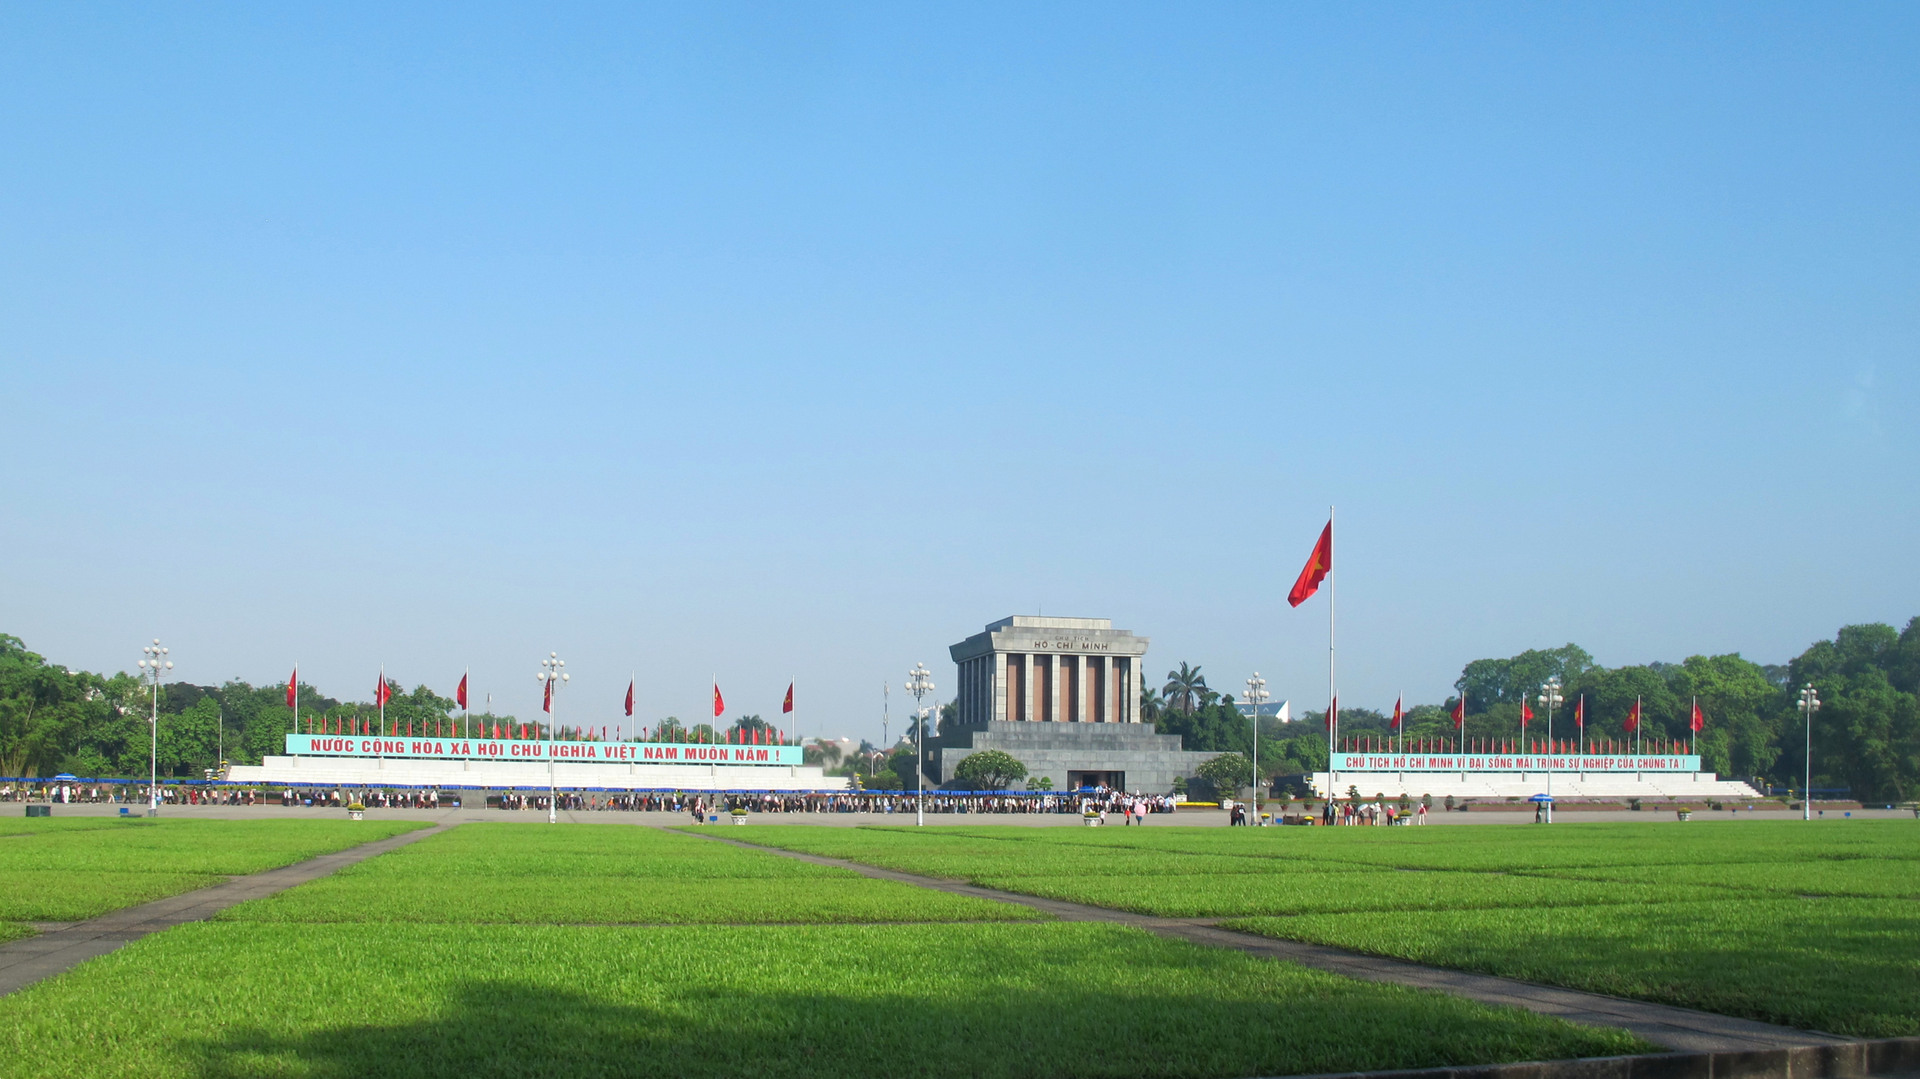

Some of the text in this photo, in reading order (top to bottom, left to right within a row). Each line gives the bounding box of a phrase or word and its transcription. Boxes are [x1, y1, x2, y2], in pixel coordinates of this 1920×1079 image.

[1082, 642, 1108, 650] MINH
[310, 737, 355, 754] NƯỚC
[361, 739, 405, 756] CỘNG
[412, 739, 444, 755] HÒA
[450, 740, 471, 755] XÃ
[477, 741, 504, 758] HỘI
[510, 741, 542, 756] CHỦ
[549, 743, 597, 758] NGHĨA
[604, 744, 637, 760] VIỆT
[644, 747, 678, 760] NAM
[685, 746, 728, 761] MUÔN
[736, 747, 769, 761] NĂM
[1346, 755, 1366, 768] CHỦ
[1369, 757, 1390, 770] TỊCH
[1409, 755, 1425, 768] CHÍ
[1429, 757, 1453, 768] MINH
[1457, 755, 1466, 768] VĨ
[1469, 757, 1485, 770] ĐẠI
[1488, 755, 1513, 769] SỐNG
[1516, 756, 1533, 768] MÃI
[1568, 757, 1580, 770] SỰ
[1583, 756, 1615, 770] NGHIỆP
[1617, 755, 1635, 769] CỦA
[1637, 756, 1666, 769] CHÚNG
[1668, 758, 1679, 769] TA
